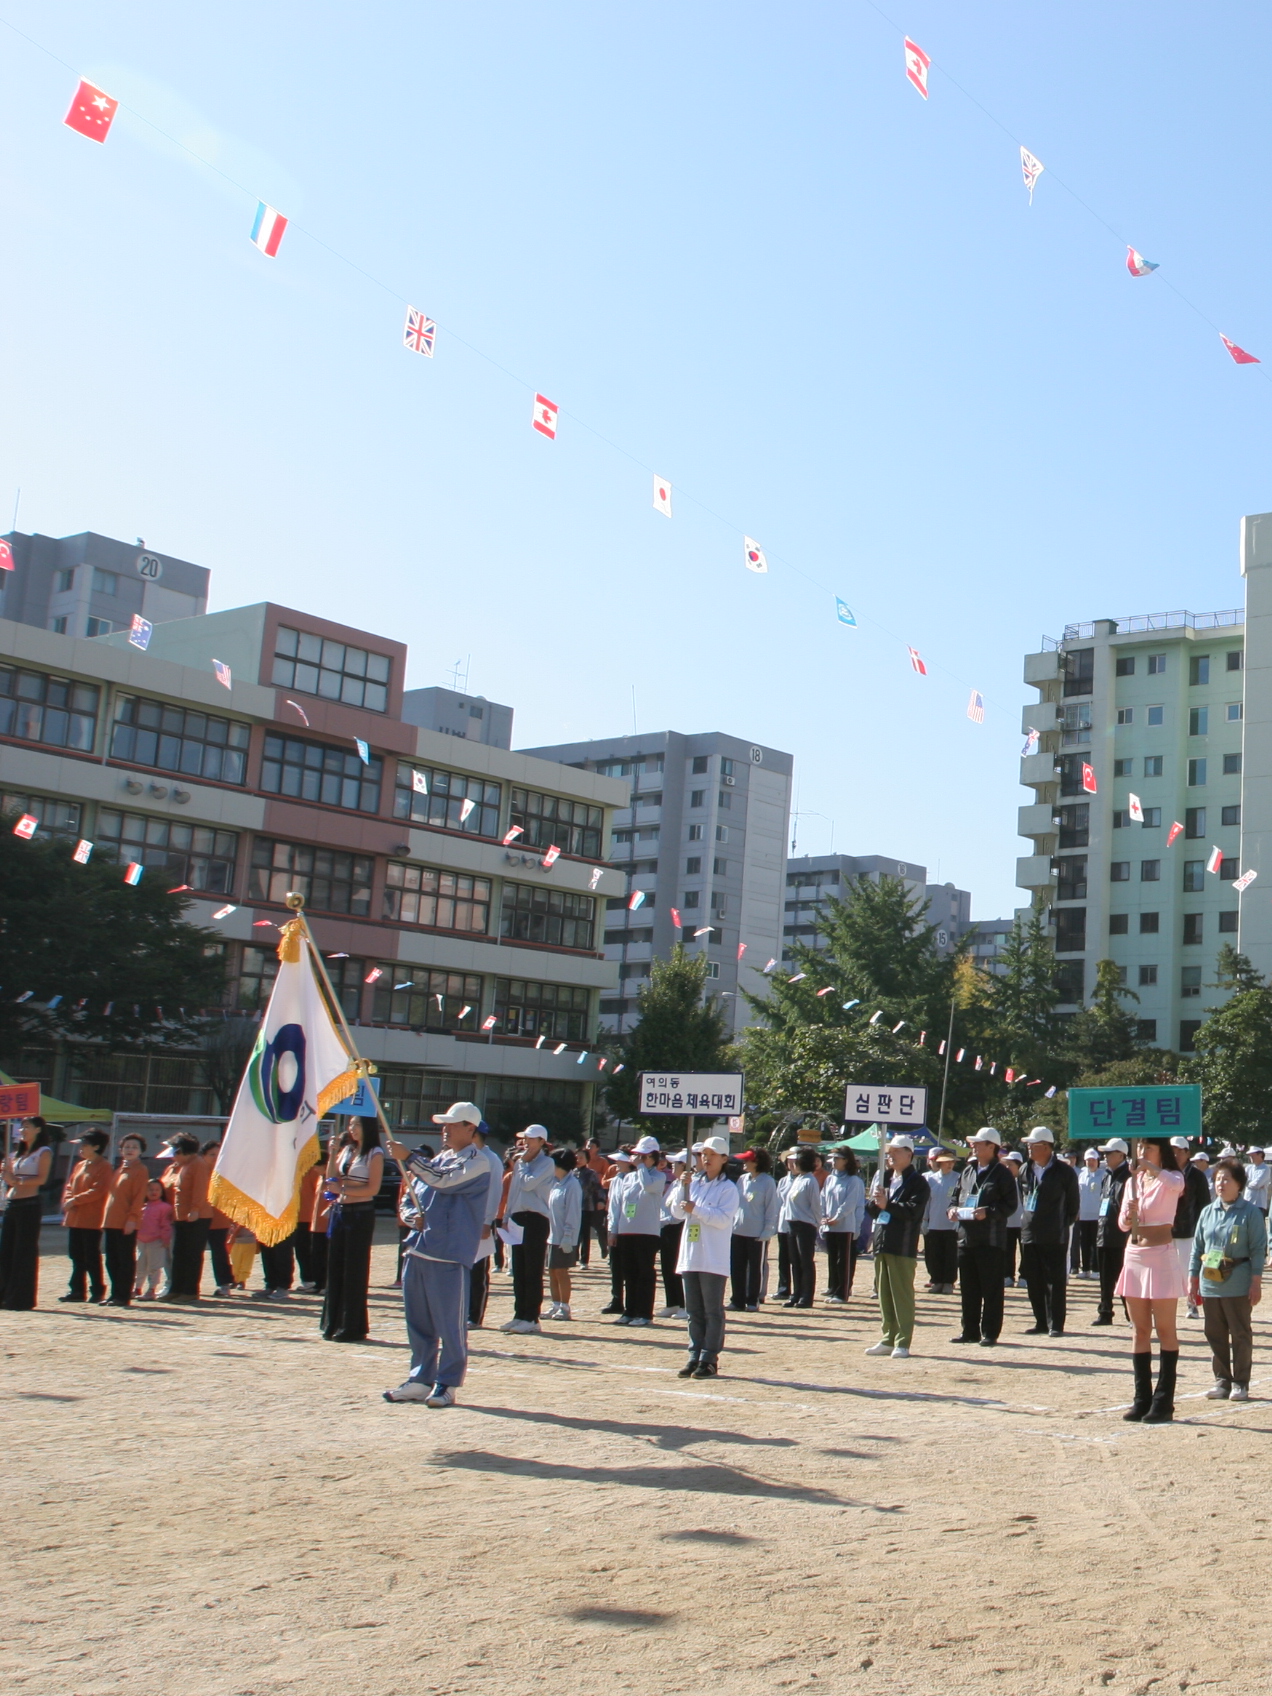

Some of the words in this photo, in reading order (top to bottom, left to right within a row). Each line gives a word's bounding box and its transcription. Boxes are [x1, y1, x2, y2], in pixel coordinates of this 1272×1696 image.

[140, 556, 158, 578] 20
[751, 748, 761, 762] 18
[646, 1077, 680, 1089] 여의동
[646, 1092, 683, 1109] 한마음
[686, 1093, 736, 1110] 체육대회
[856, 1093, 915, 1116] 심판단
[1089, 1097, 1181, 1127] 단결팀
